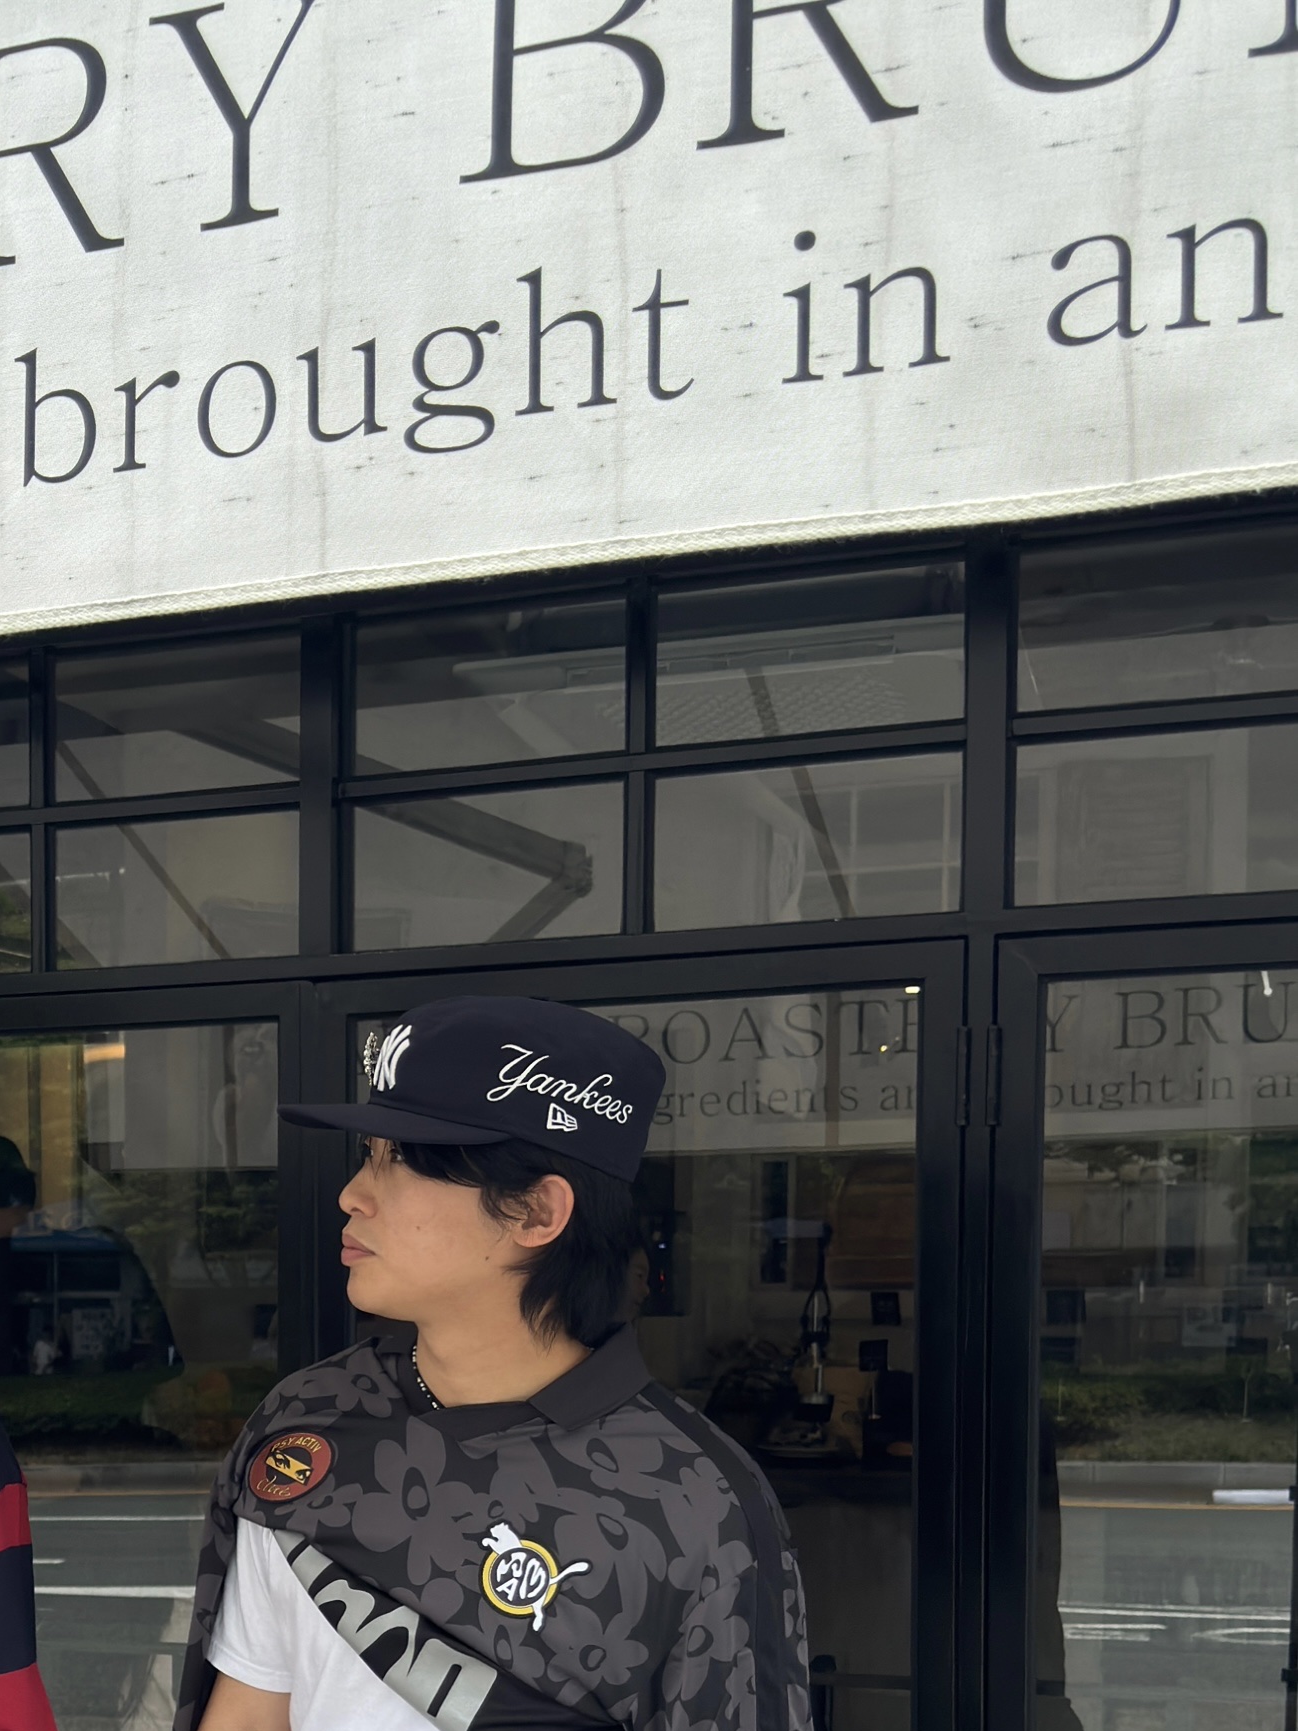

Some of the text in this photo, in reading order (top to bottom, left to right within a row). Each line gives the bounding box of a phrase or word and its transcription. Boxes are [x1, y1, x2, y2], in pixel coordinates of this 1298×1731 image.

[459, 0, 1298, 184] BR
[16, 266, 695, 487] brought
[782, 230, 951, 384] in
[1046, 216, 1283, 348] an
[486, 1043, 633, 1124] Yankees
[652, 1080, 859, 1126] grediens
[1196, 1066, 1234, 1100] in
